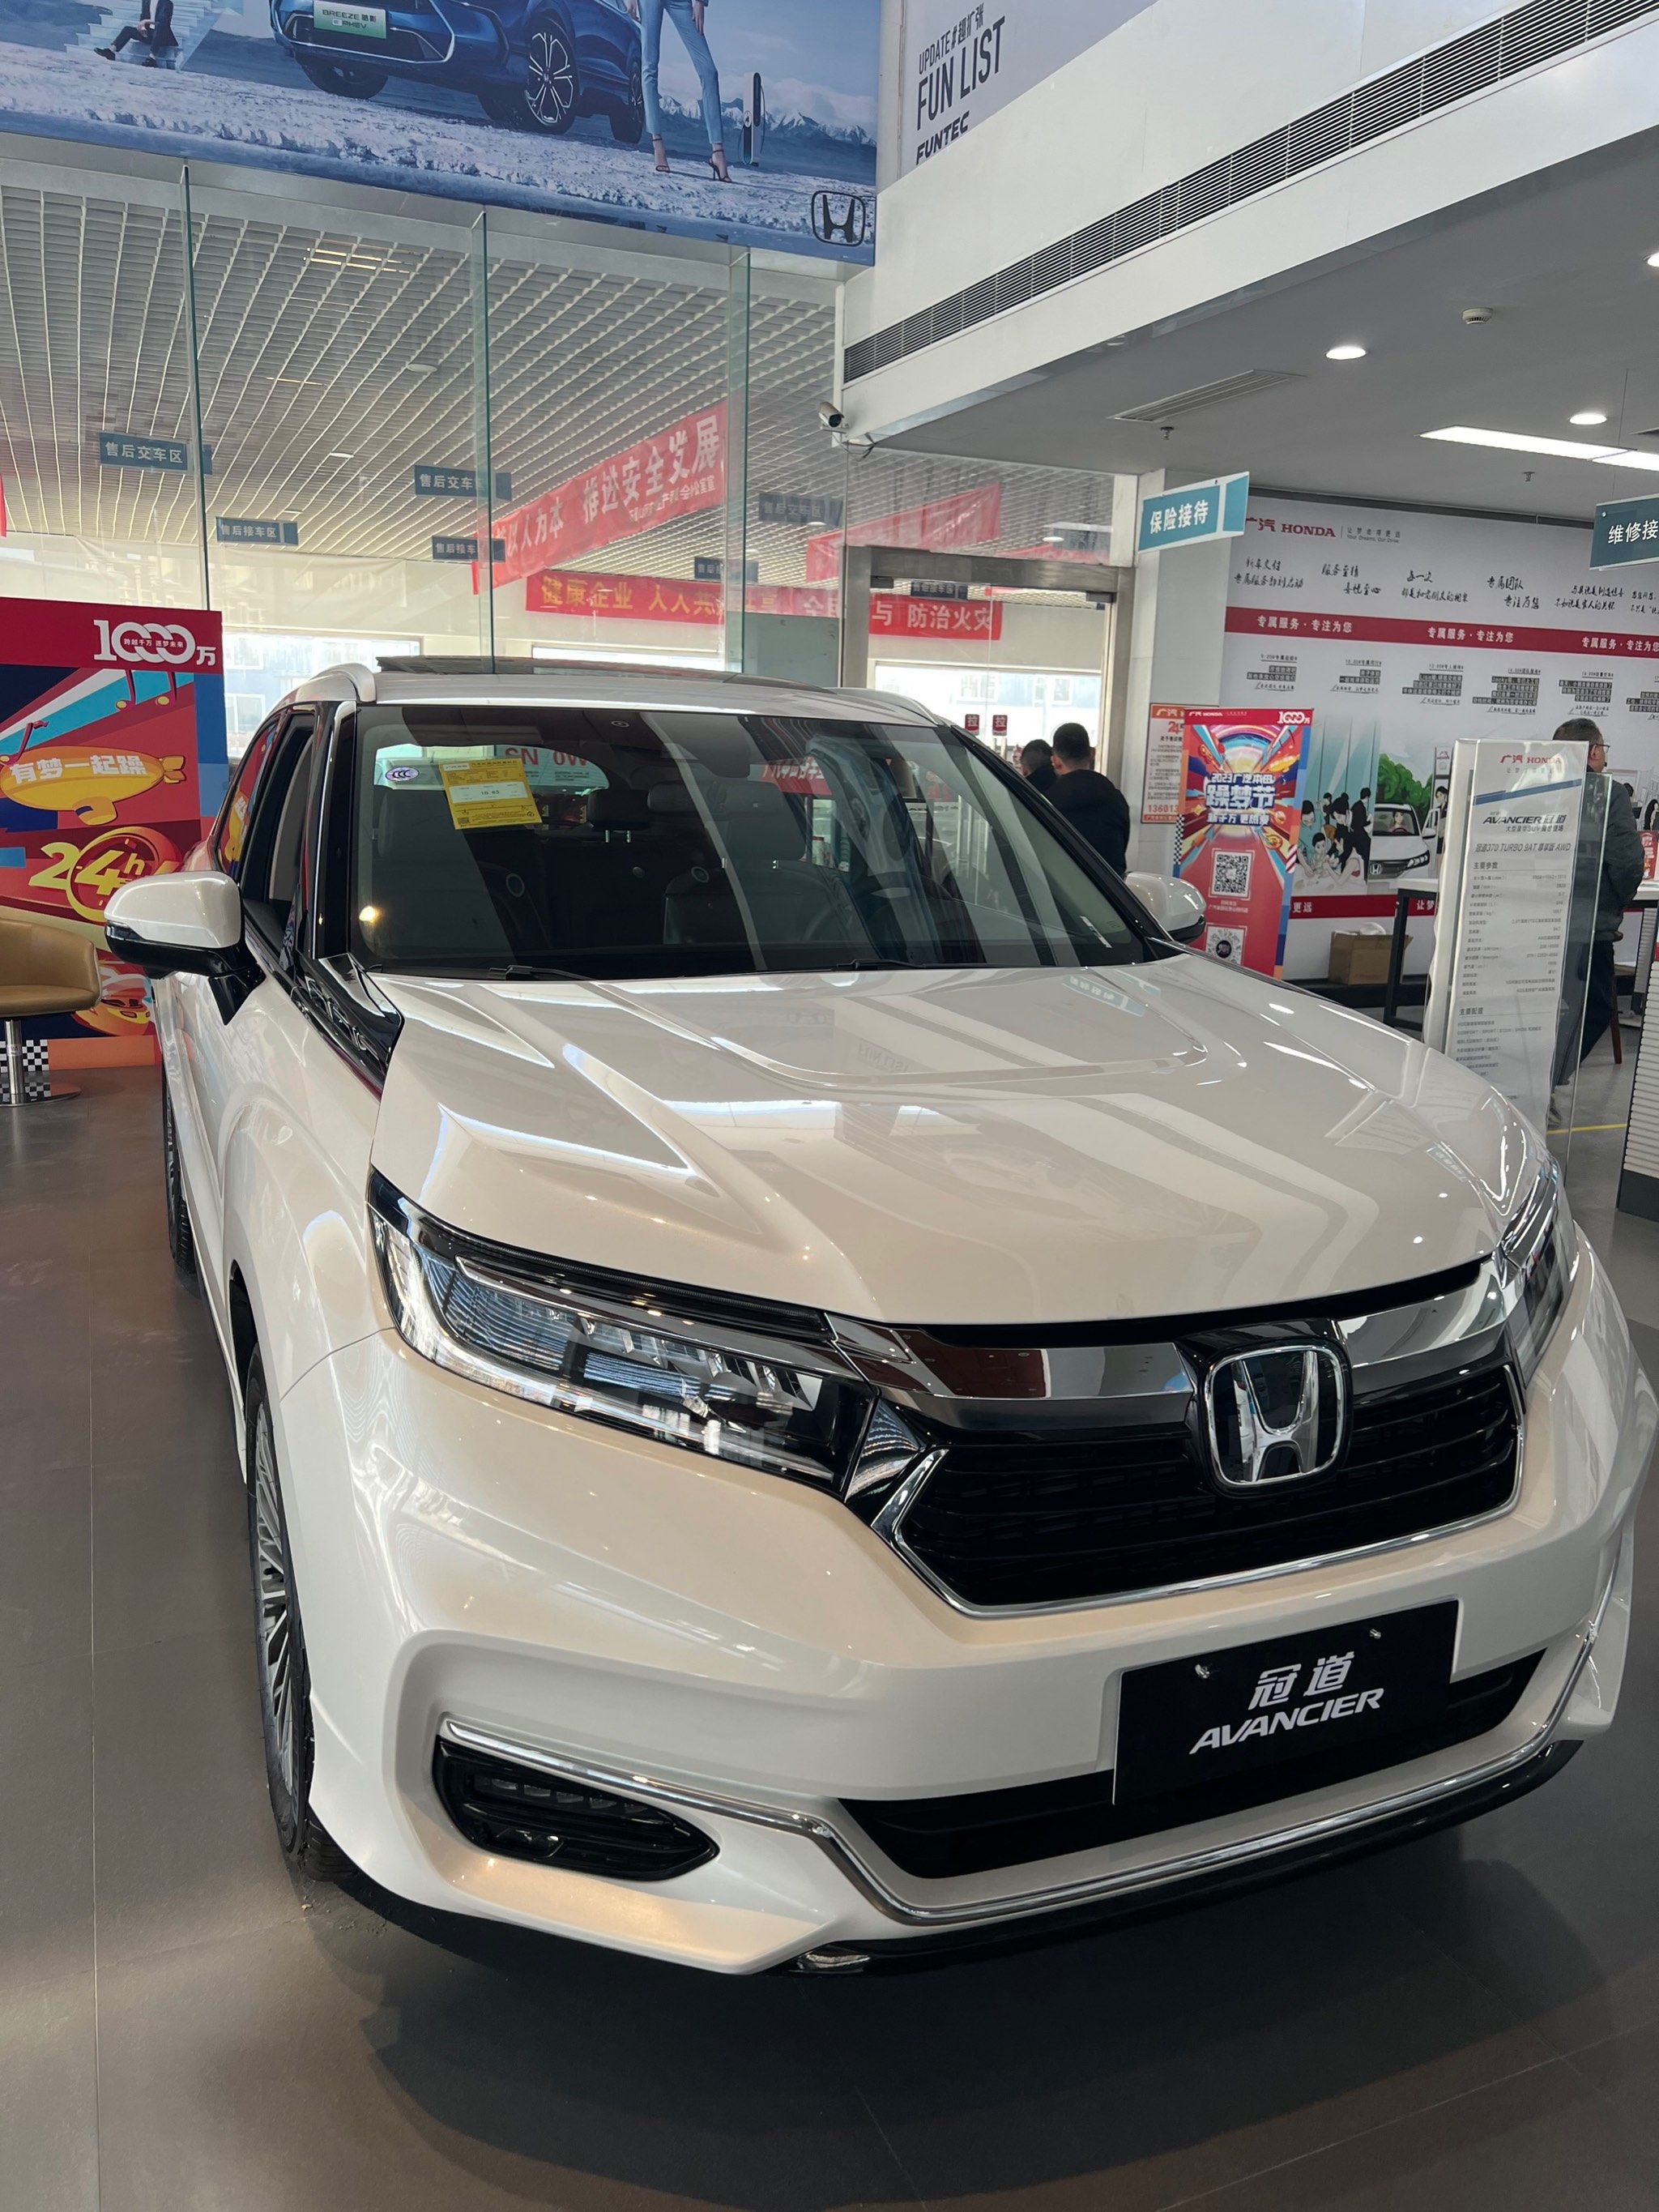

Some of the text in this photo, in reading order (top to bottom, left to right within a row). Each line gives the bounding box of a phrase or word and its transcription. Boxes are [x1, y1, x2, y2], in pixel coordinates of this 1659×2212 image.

[322, 10, 360, 19] BREEZE
[919, 30, 950, 75] UPDATE
[917, 15, 1005, 130] FUN LIST
[916, 110, 970, 165] FUNTEC
[104, 441, 184, 464] 售后交车区
[420, 473, 473, 490] 售后交车
[1149, 499, 1209, 535] 保险接待
[1281, 523, 1337, 538] HONDA
[1608, 519, 1659, 544] 维修接
[872, 600, 893, 626] 与
[906, 603, 991, 631] 防治火灾
[1257, 615, 1352, 633] 专属服务·专注为您
[1427, 626, 1514, 643] 专属服务·专注为您
[1500, 754, 1524, 764] 广汽
[1483, 816, 1542, 825] AVANCIER
[1292, 901, 1312, 913] 更远
[1247, 1650, 1355, 1710] 冠道
[1188, 1688, 1384, 1755] AVANCIER
